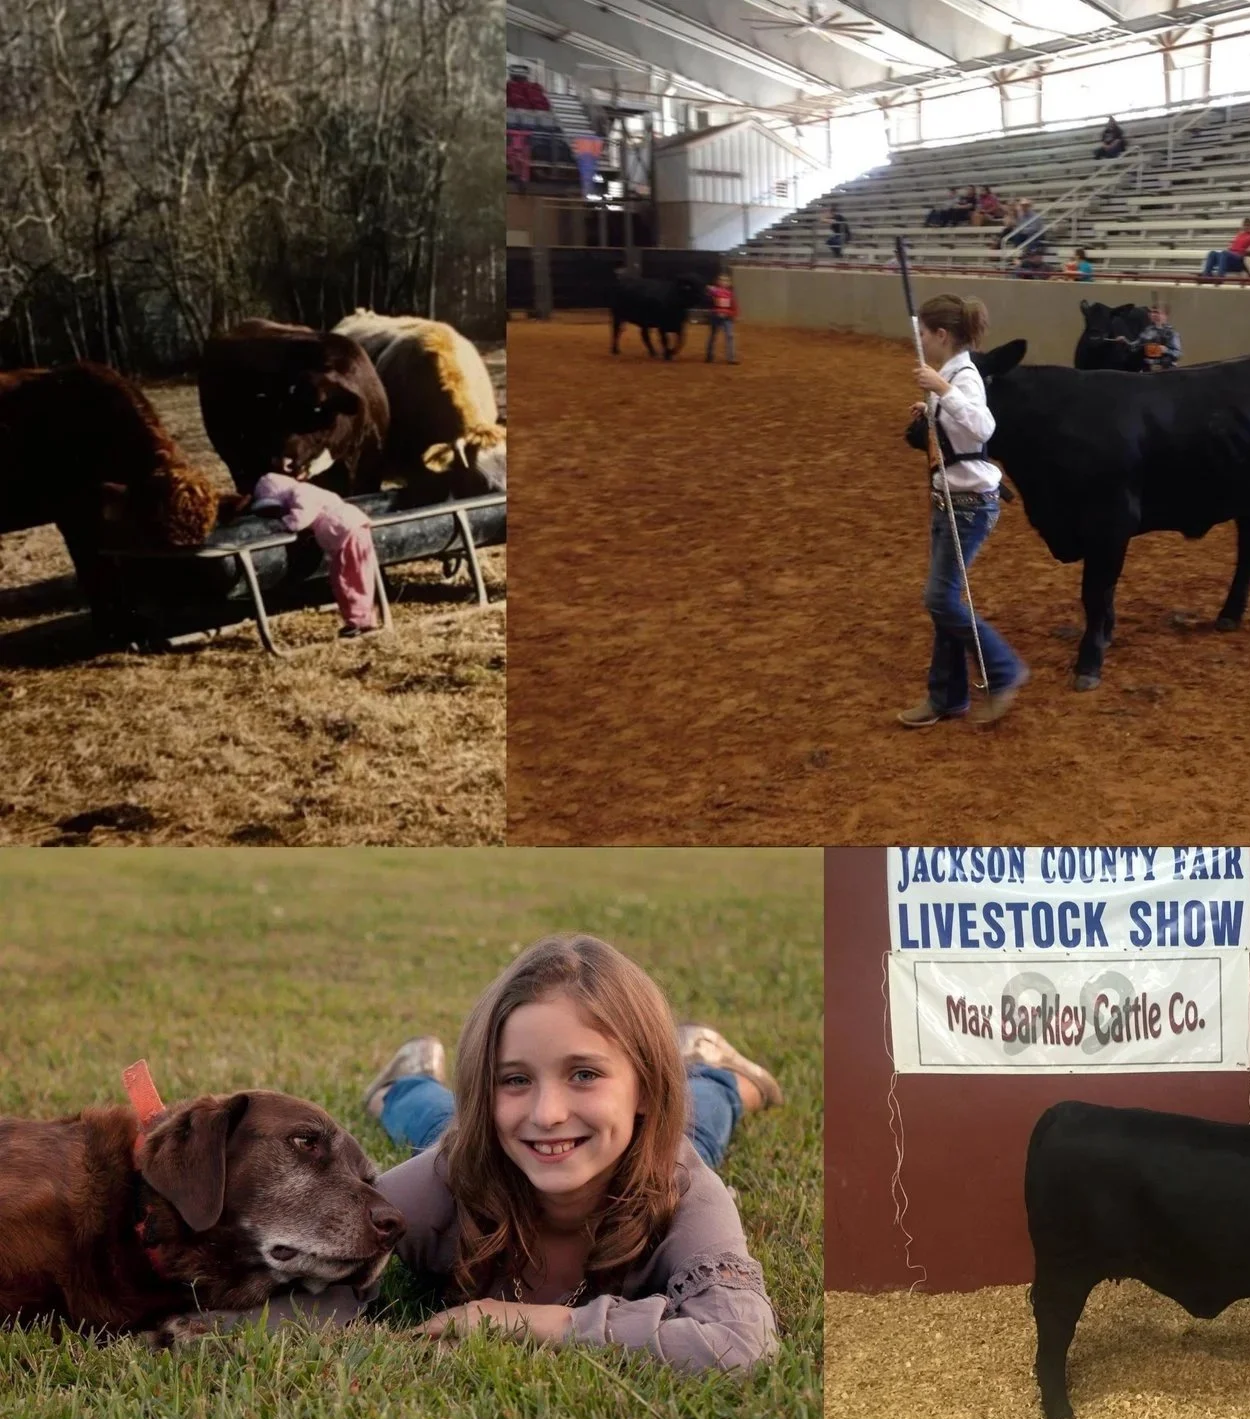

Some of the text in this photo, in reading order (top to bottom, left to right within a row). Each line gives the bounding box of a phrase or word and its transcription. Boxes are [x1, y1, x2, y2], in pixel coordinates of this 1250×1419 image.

[897, 847, 1244, 892] JACKSON COUNTY FAIR
[898, 900, 1244, 949] LIVESTOCK SHOW
[946, 992, 1205, 1046] Max Barkley Cattle Co.
